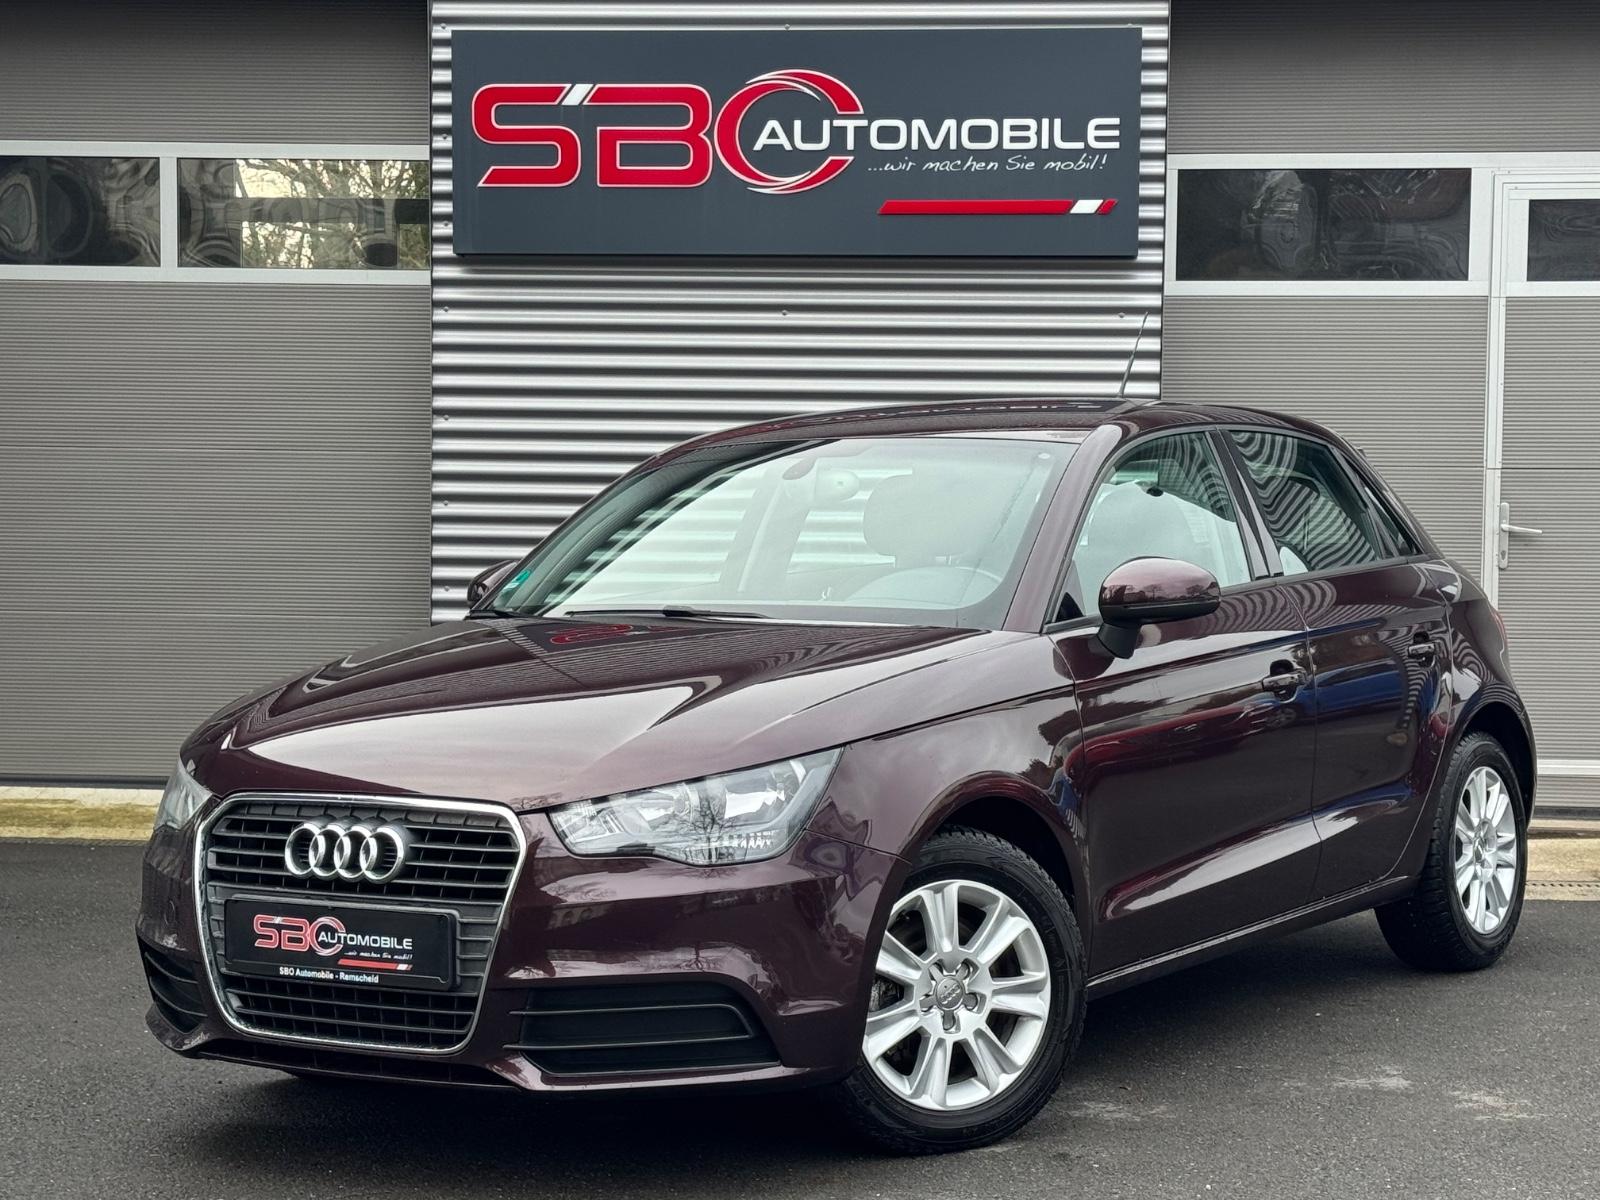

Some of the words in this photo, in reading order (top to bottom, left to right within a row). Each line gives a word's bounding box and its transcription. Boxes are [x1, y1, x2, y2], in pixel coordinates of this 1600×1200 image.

[471, 69, 864, 195] SBO
[752, 117, 1121, 152] AUTOMOBILE
[867, 156, 916, 172] ...wir
[922, 156, 999, 172] machen
[1006, 154, 1036, 171] Sie
[1043, 153, 1108, 171] mobil!
[253, 914, 345, 957] SBO
[317, 930, 413, 950] AUTOMOBILE
[279, 966, 295, 976] SBO
[295, 968, 334, 980] Automobile
[339, 972, 379, 984] Remscheid
